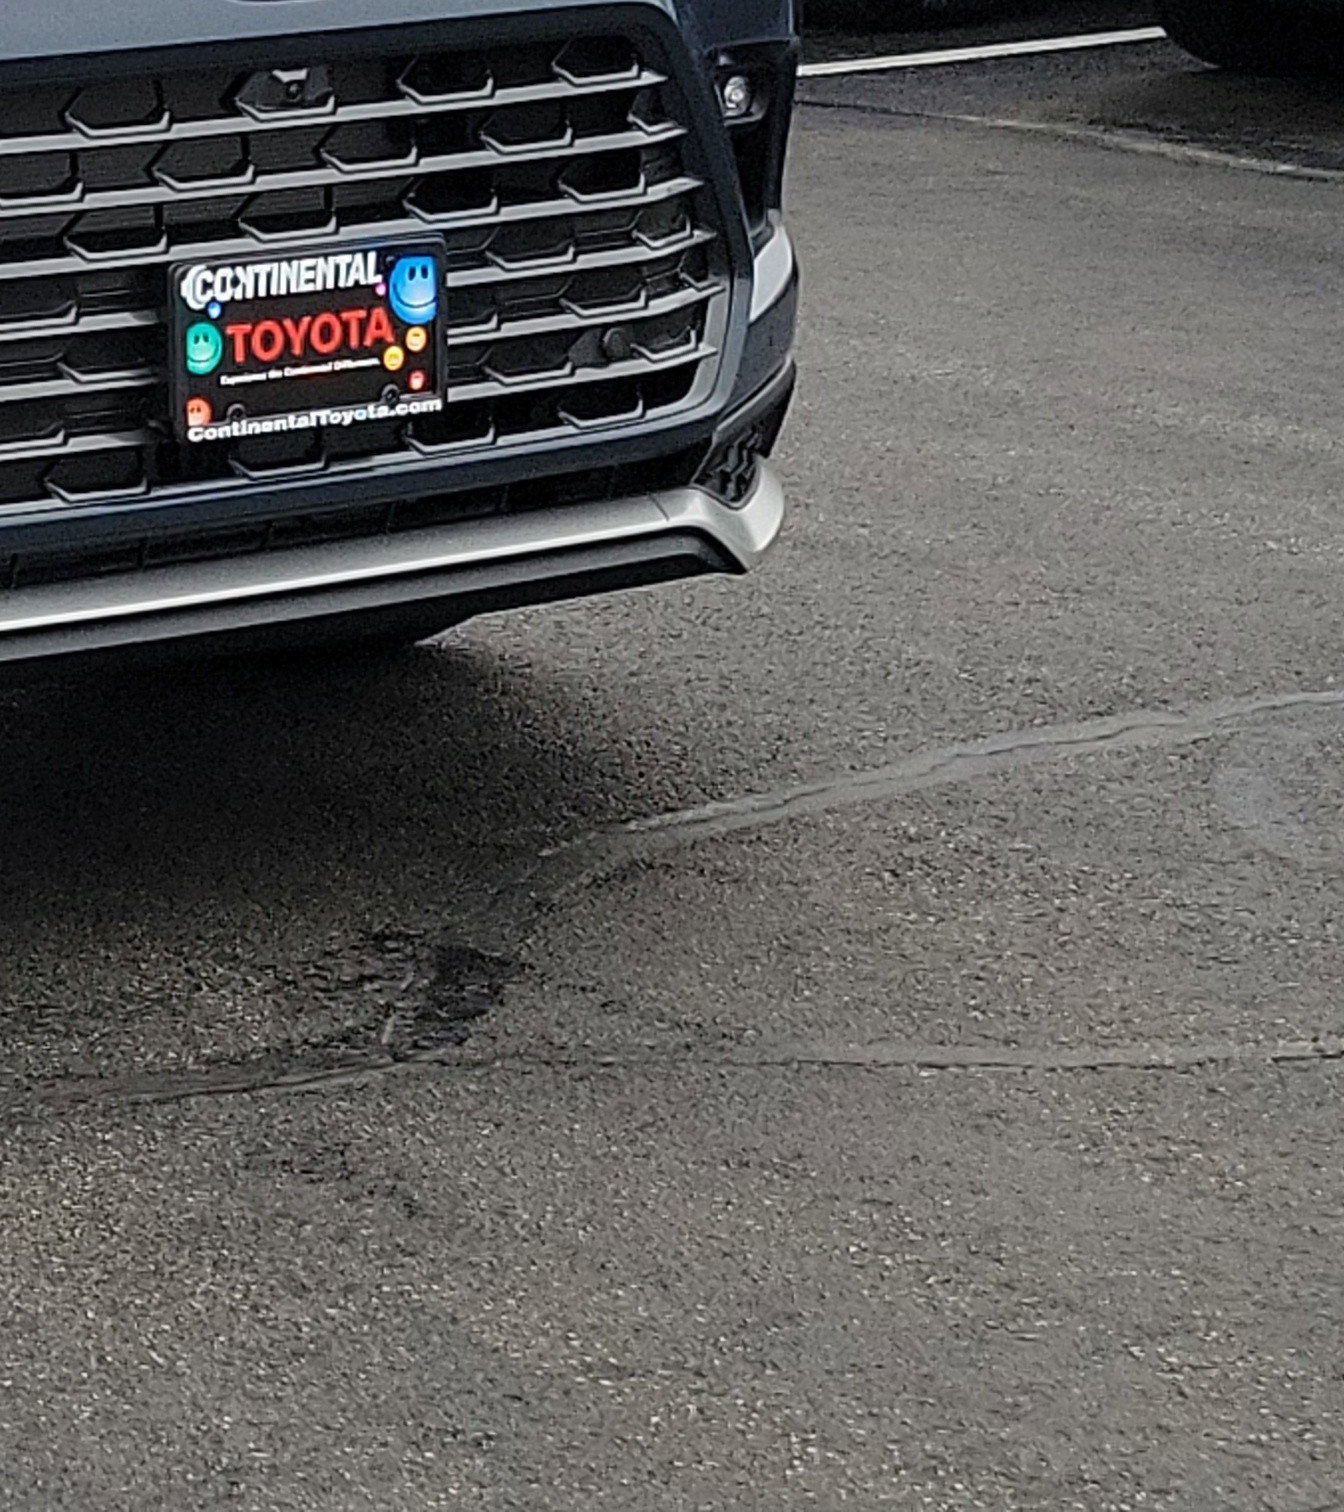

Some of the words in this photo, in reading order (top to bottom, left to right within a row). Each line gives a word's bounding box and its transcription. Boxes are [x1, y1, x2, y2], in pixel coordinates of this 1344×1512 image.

[180, 250, 383, 311] CONTINENTAL
[225, 306, 395, 365] TOYOTA
[187, 397, 443, 443] ContinentalToyota.com
